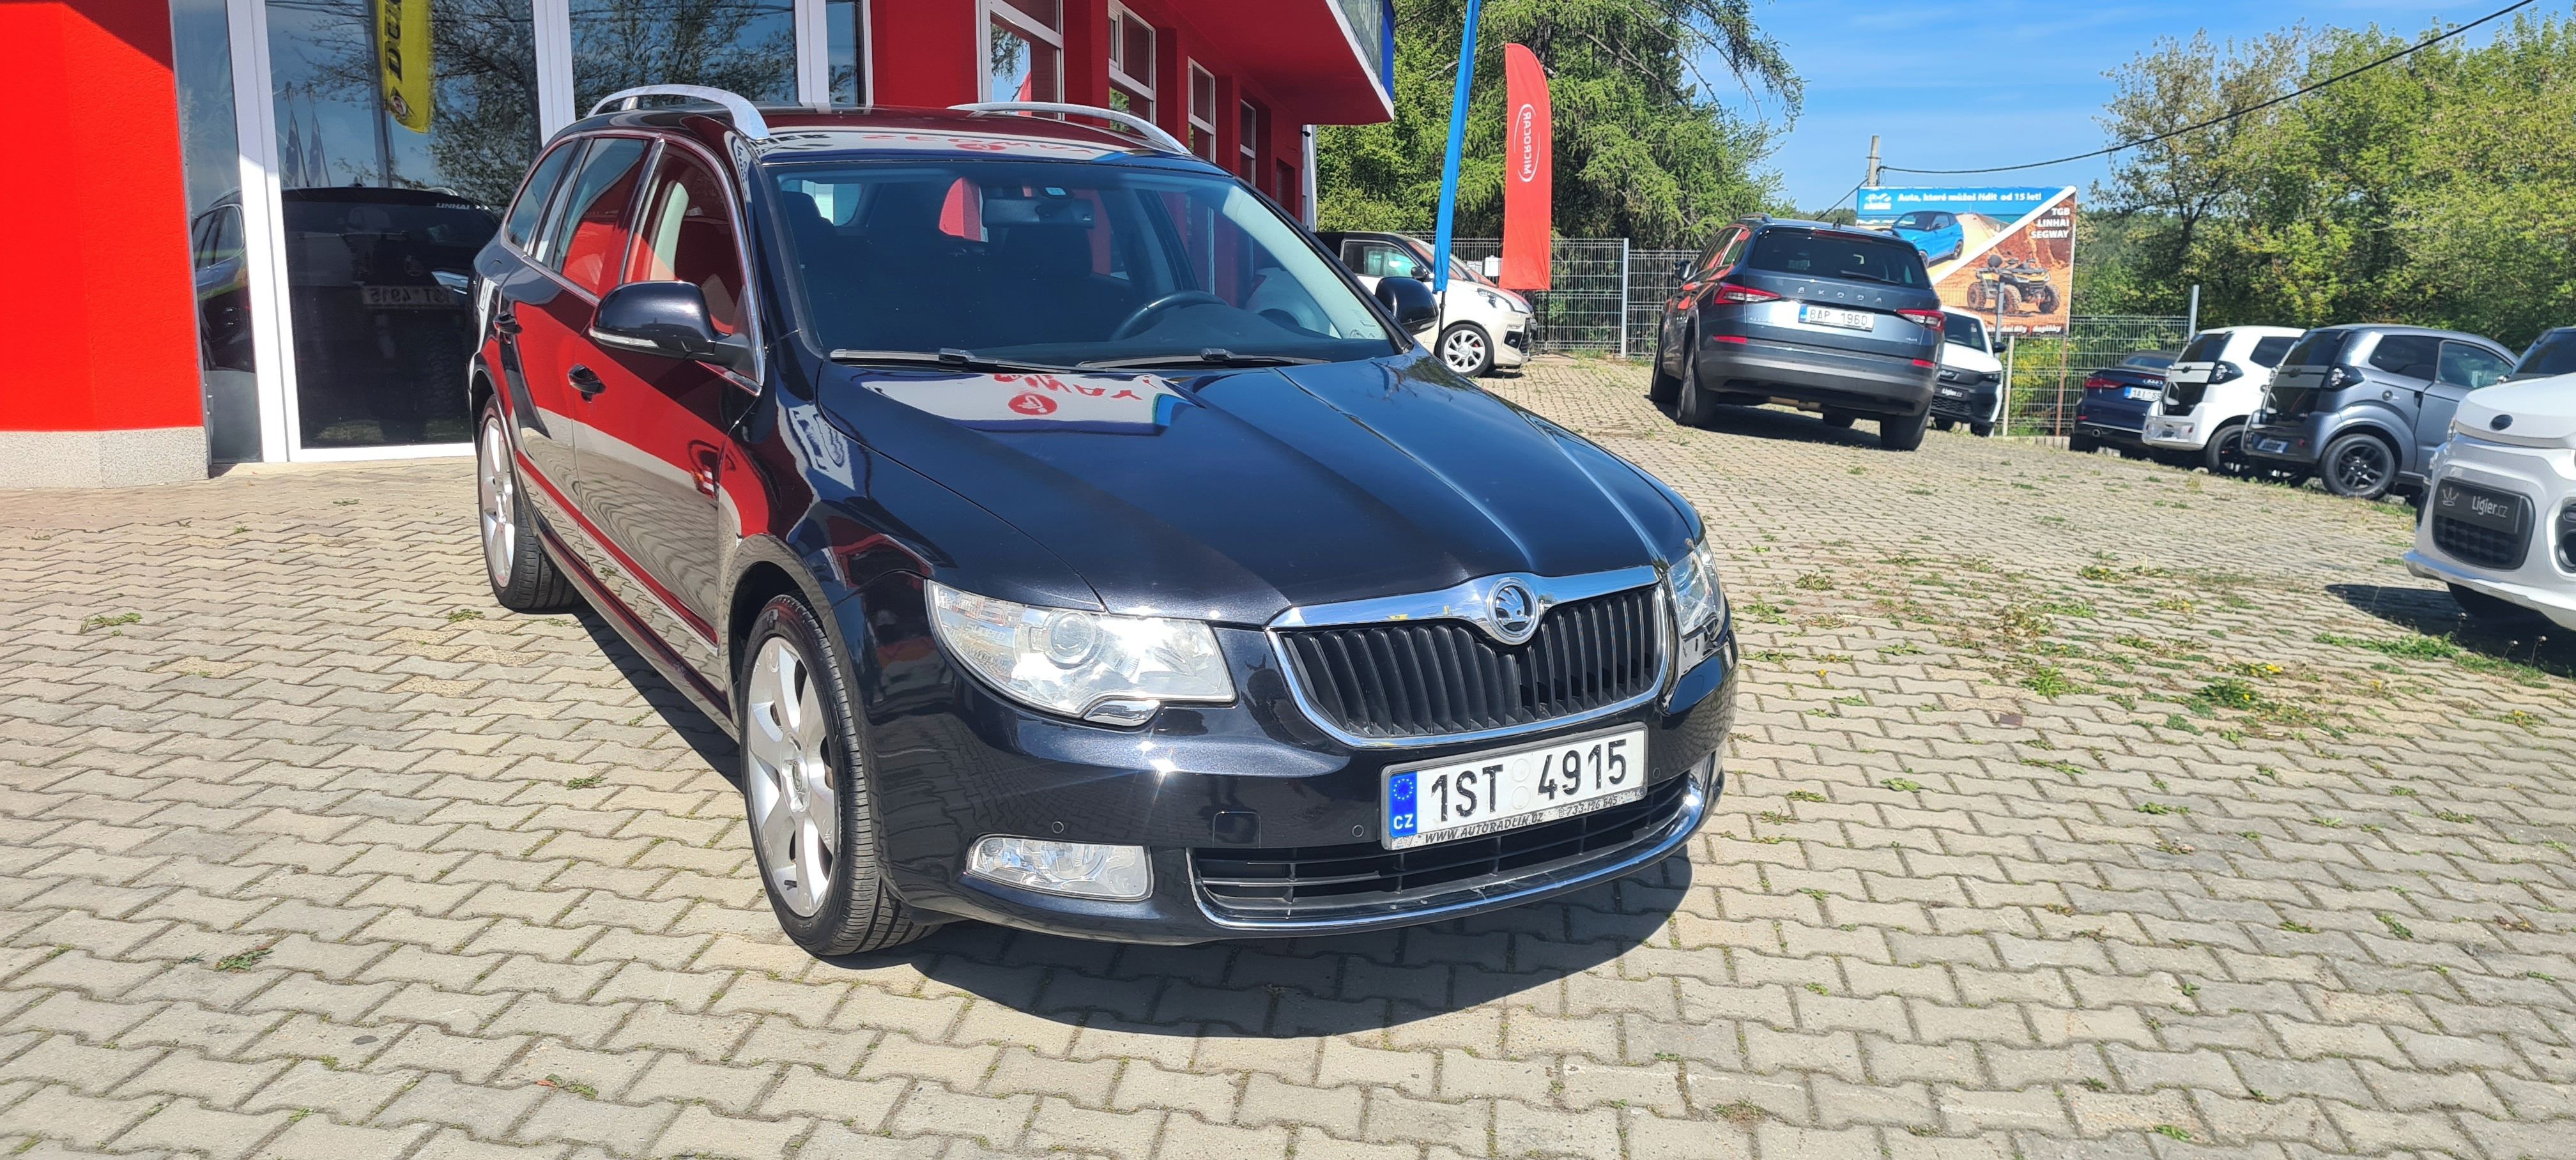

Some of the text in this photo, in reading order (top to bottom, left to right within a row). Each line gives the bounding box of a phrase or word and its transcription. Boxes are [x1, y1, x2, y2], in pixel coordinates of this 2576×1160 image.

[1897, 193, 1922, 202] Auta,
[1923, 193, 1947, 201] které
[2000, 192, 2012, 201] od
[2015, 193, 2025, 201] 15
[2051, 208, 2071, 216] TGB
[2037, 218, 2070, 227] LINHAI
[2031, 230, 2069, 238] SEGWAY
[1809, 309, 1867, 326] 8AP 1960
[2472, 495, 2508, 518] Ligier.cz
[1431, 738, 1627, 822] 1ST 4915
[1393, 813, 1414, 830] CZ
